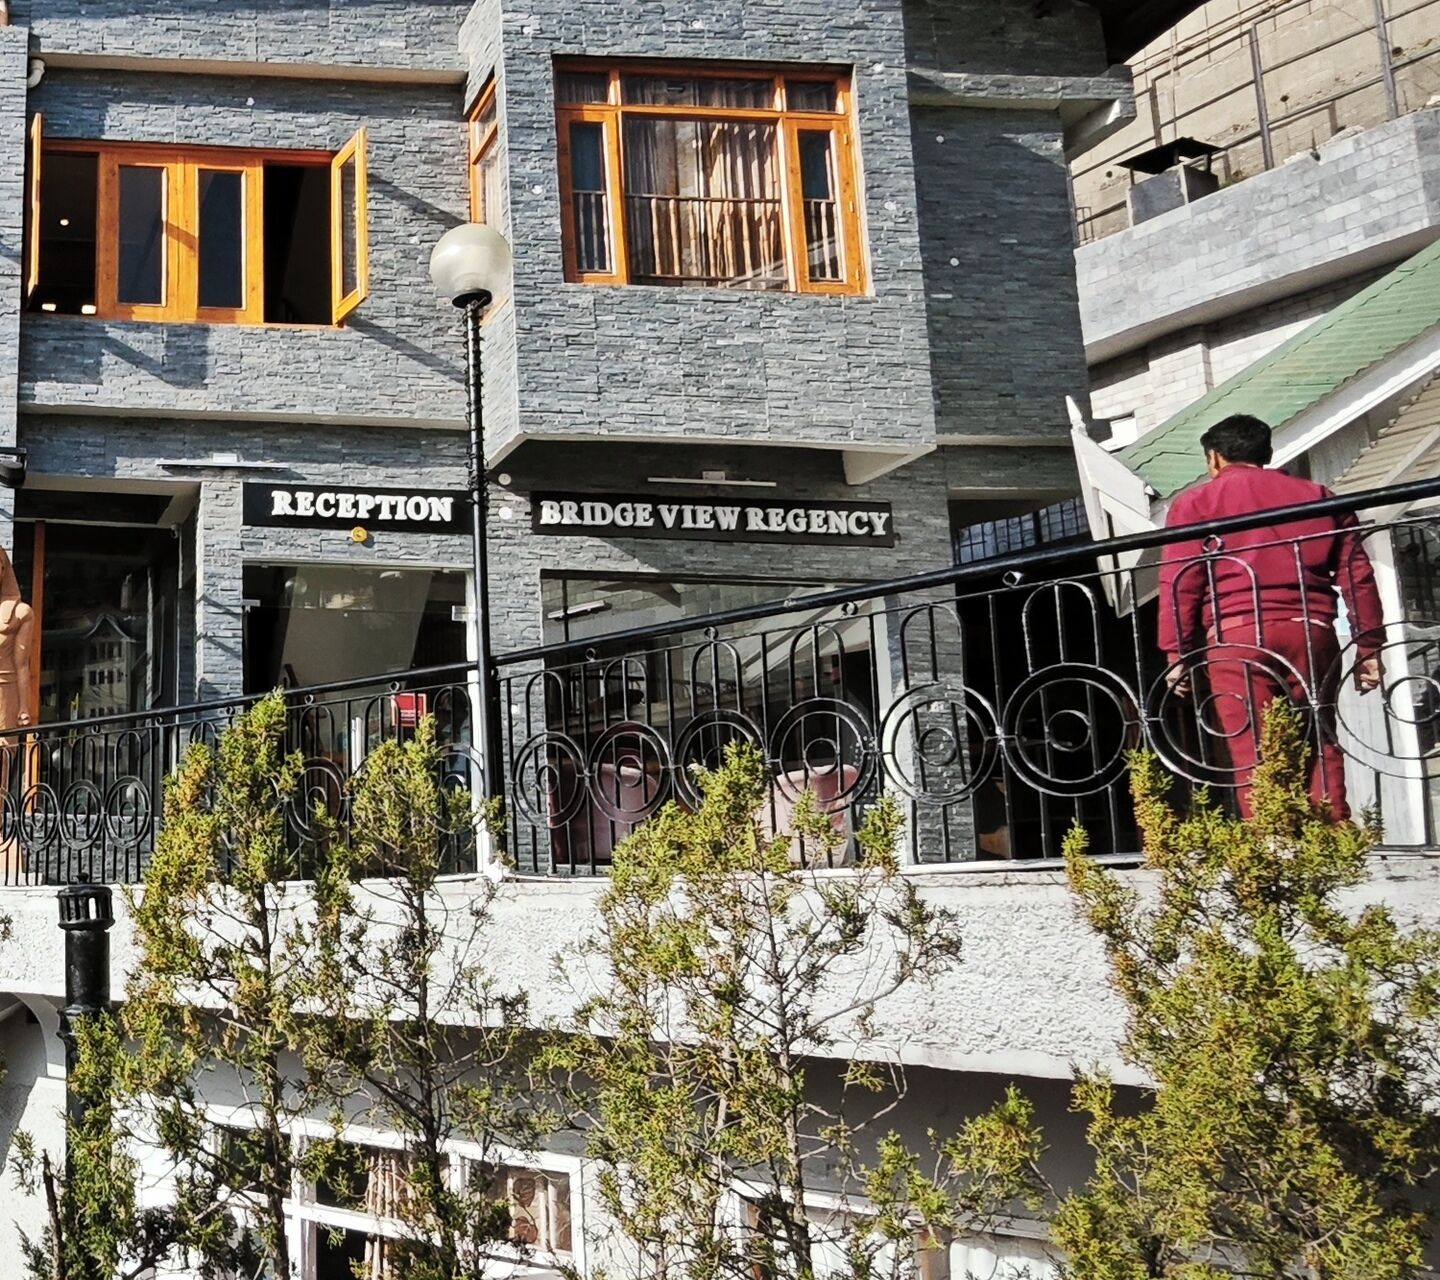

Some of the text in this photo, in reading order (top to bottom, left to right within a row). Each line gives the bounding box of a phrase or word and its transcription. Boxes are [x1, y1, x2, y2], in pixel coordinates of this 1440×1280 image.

[271, 490, 454, 522] RECEPTION
[539, 500, 890, 536] BRIDGE VIEW REGENCY
